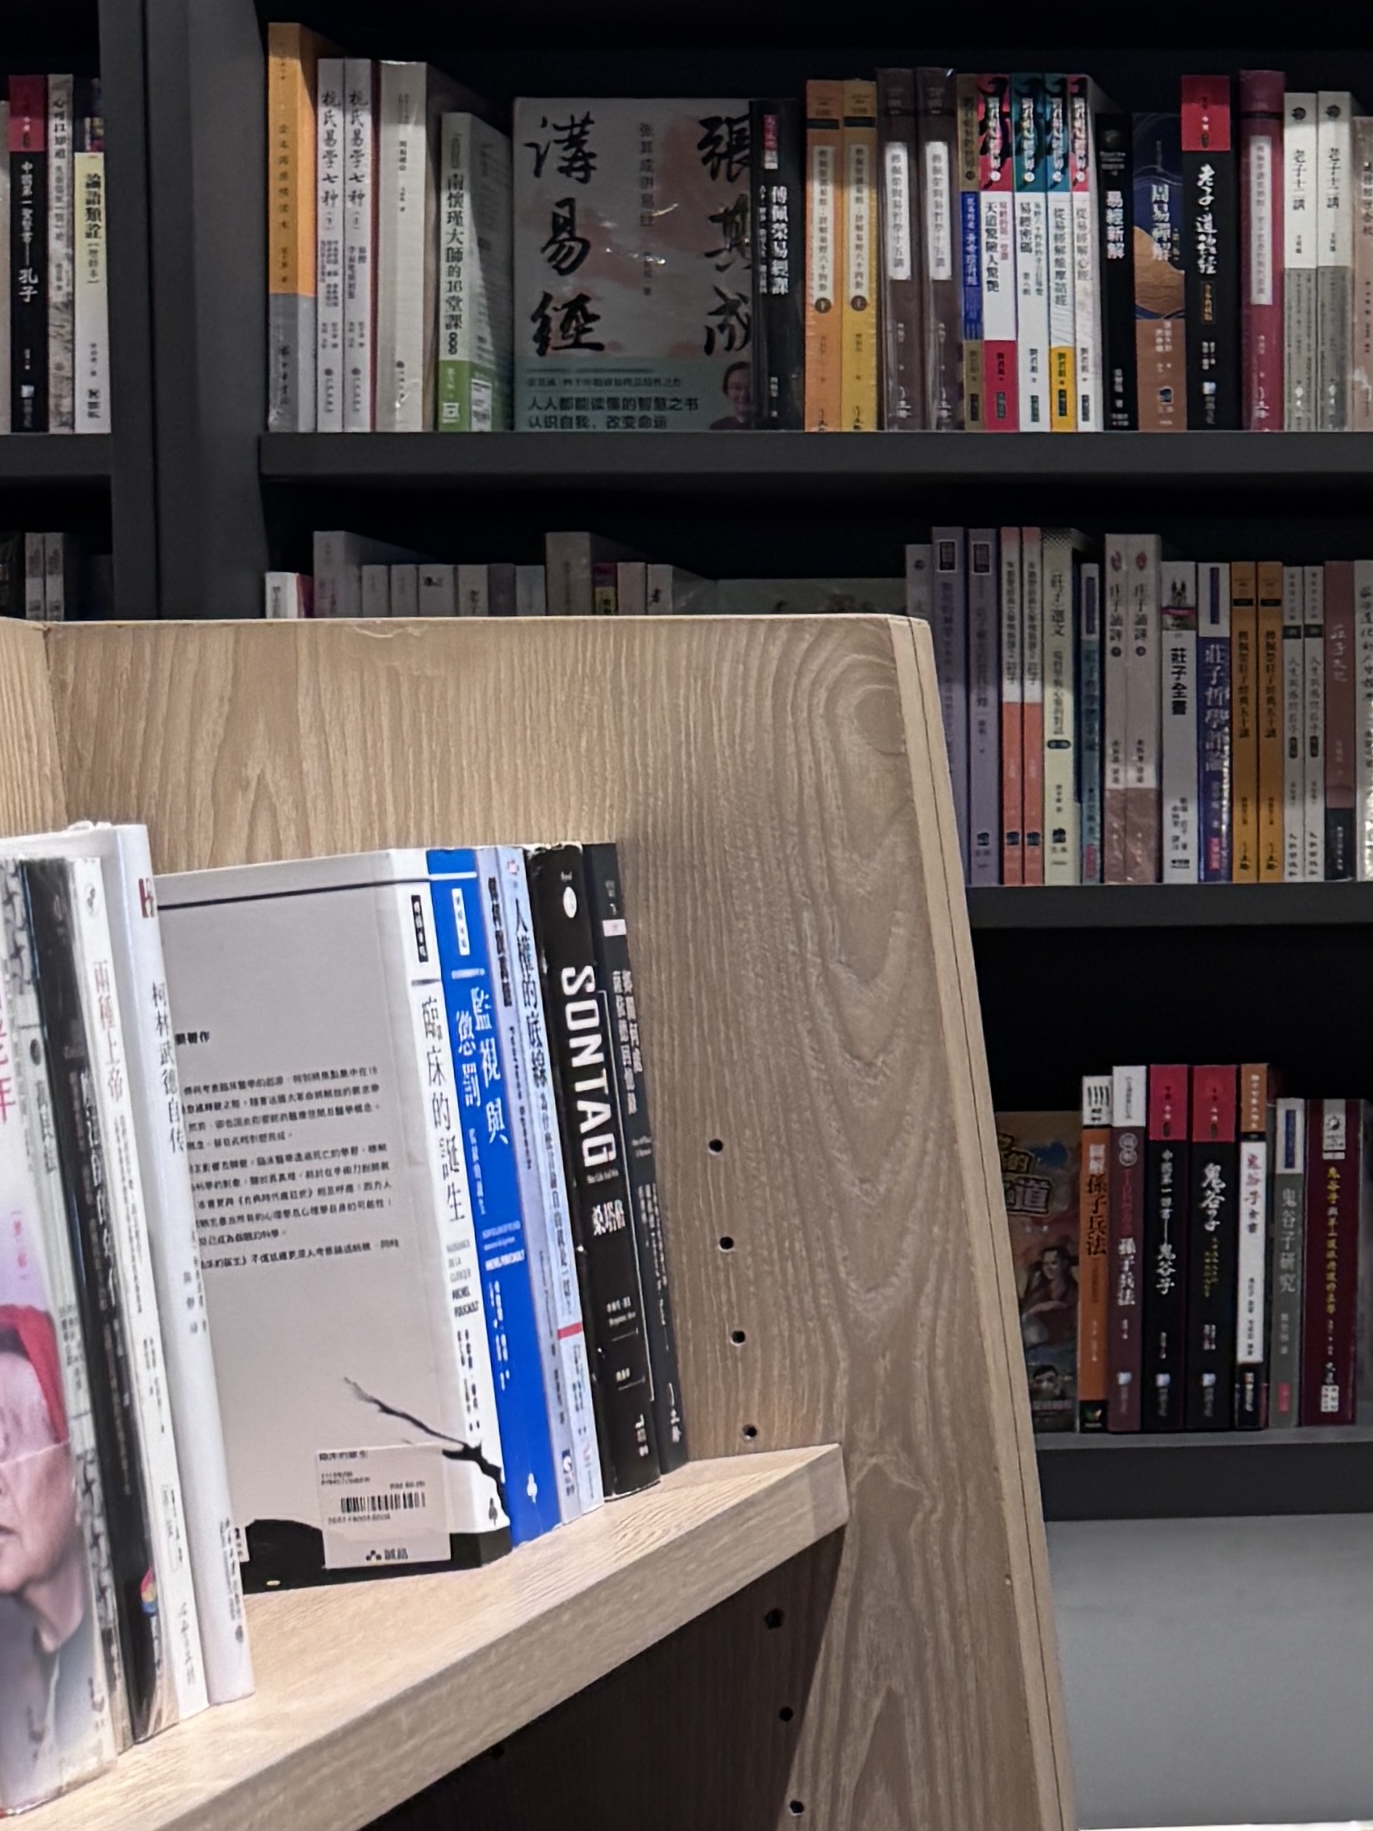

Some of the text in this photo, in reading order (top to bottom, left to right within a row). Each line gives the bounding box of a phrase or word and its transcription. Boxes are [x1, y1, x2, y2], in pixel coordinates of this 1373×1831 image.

[445, 173, 463, 332] 南懷瑾大師的16堂課
[1107, 190, 1124, 260] 易經新解
[1170, 647, 1187, 716] 莊子全書
[152, 981, 187, 1155] 柯林武德自传
[455, 1009, 482, 1109] 懲罰
[470, 986, 509, 1147] 監視與
[513, 896, 548, 1089] 人權的底線
[561, 964, 616, 1170] SONTAG
[421, 995, 464, 1226] 臨床的誕生
[1202, 1162, 1226, 1233] 鬼谷子
[1280, 1187, 1297, 1294] 鬼谷子研究
